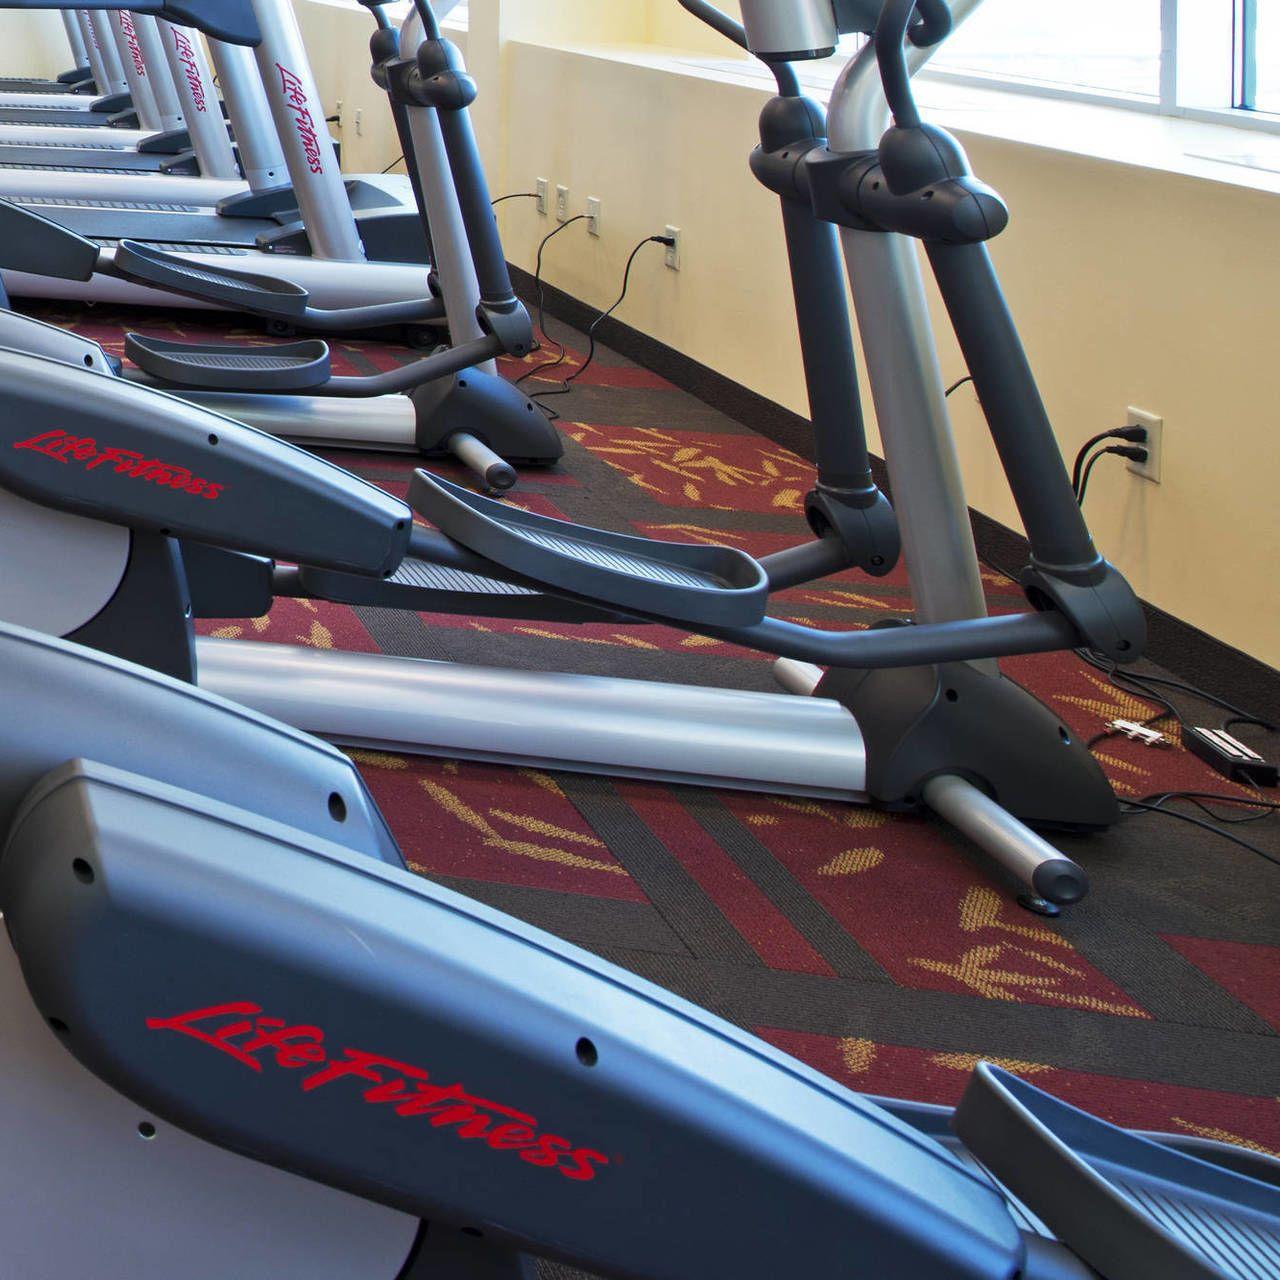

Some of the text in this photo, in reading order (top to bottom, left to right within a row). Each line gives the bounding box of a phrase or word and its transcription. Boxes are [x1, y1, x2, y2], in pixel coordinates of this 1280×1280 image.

[178, 56, 206, 113] Fitness
[275, 62, 323, 175] Life Fitness
[13, 429, 224, 499] Life Fitness
[146, 1001, 609, 1181] Life Fitness
